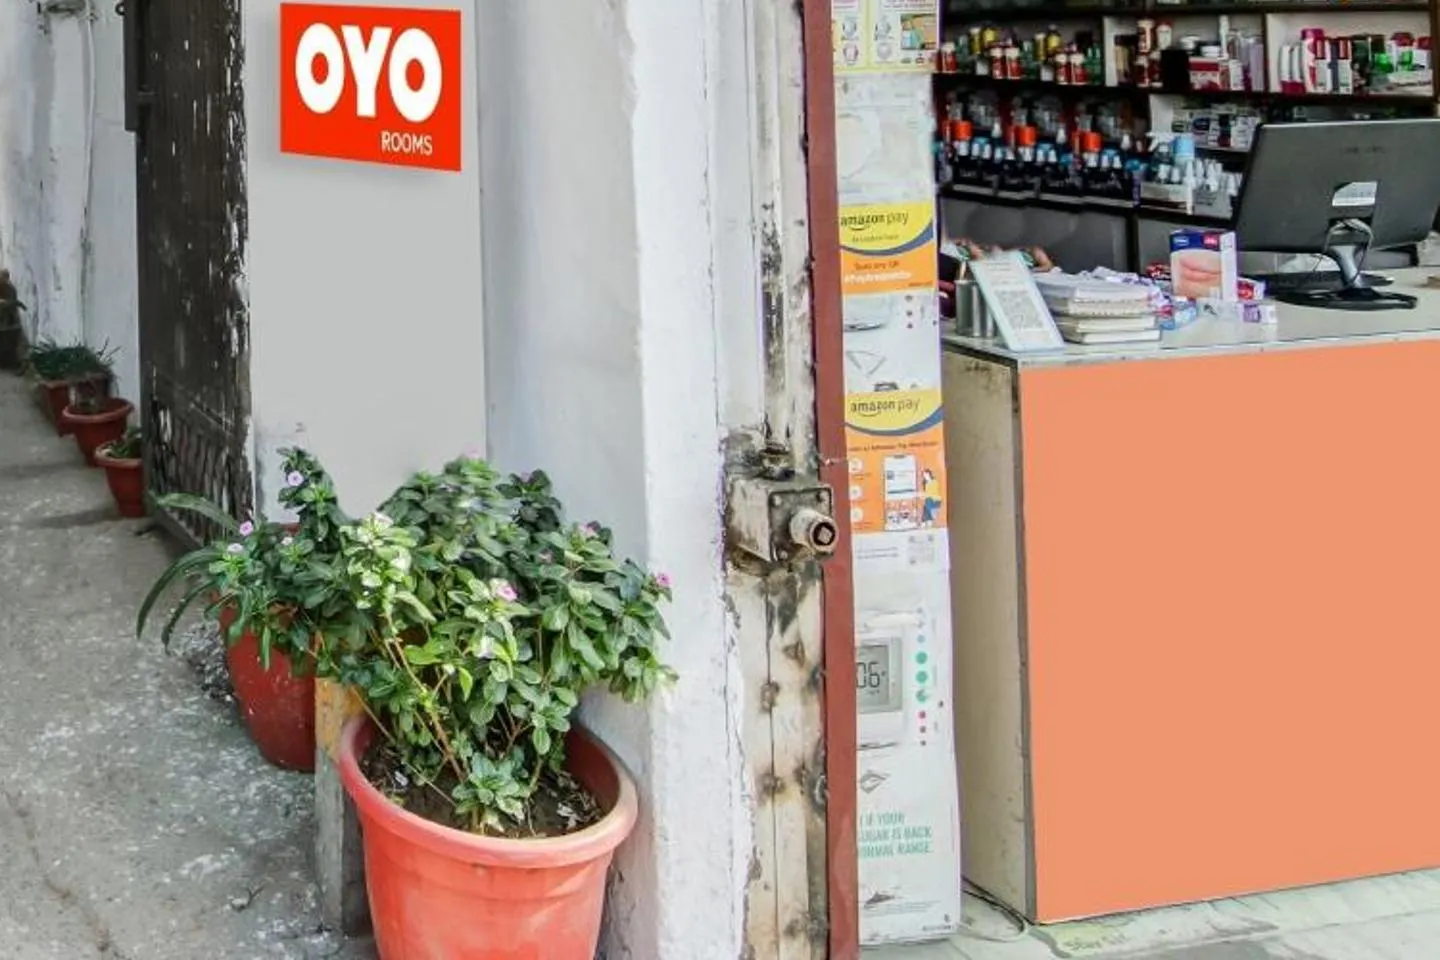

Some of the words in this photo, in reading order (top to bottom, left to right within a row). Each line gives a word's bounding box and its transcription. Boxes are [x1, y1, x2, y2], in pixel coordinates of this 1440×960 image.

[295, 22, 442, 123] OYO
[381, 130, 433, 155] ROOMS
[841, 214, 886, 227] amazon
[850, 401, 896, 413] amazon
[897, 397, 921, 413] pay
